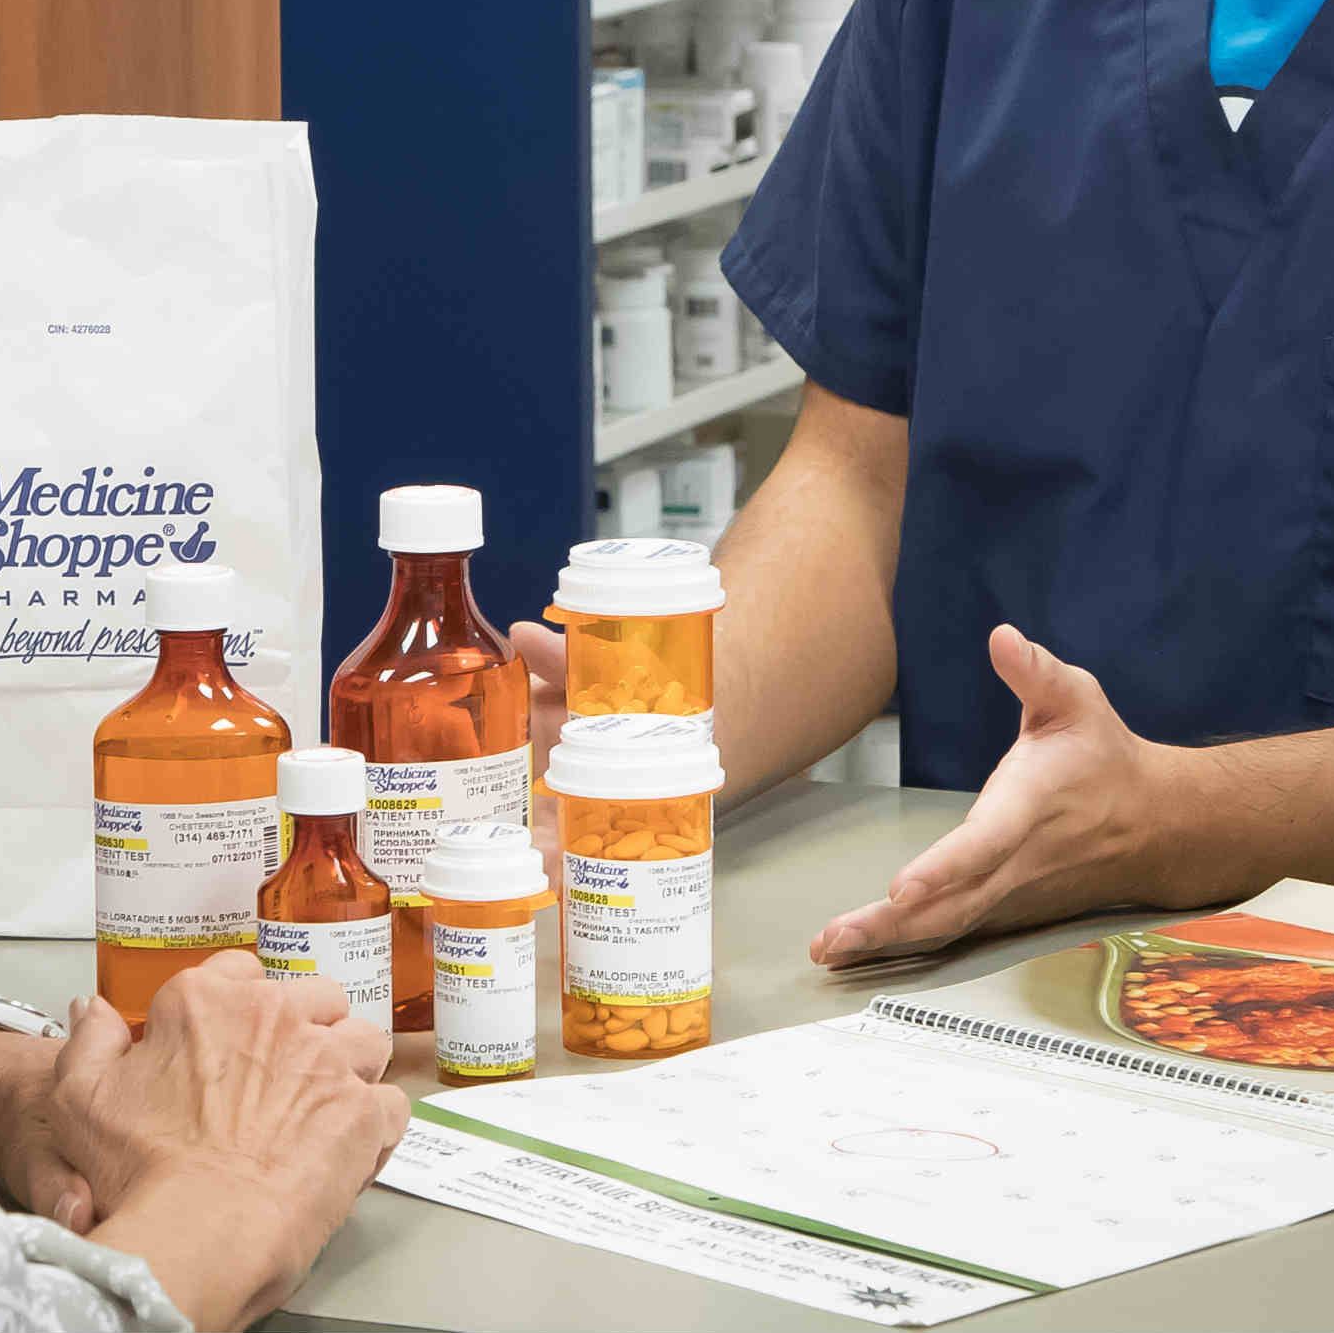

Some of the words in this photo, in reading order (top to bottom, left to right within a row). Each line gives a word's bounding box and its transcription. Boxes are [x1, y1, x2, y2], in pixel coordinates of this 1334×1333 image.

[47, 324, 70, 335] CIN:
[368, 767, 436, 782] Medicine
[374, 779, 425, 793] Shoppe
[368, 799, 418, 810] 1008629
[365, 810, 414, 822] PATIENT
[419, 810, 444, 819] TEST
[174, 832, 203, 844] (314)
[373, 839, 436, 847] ИСПОЛЬЗОВА
[124, 852, 152, 862] TEST
[211, 850, 263, 864] 07/12/2017
[570, 858, 629, 876] Medicine
[573, 873, 616, 889] Shoppe
[567, 900, 604, 916] PATIENT
[609, 908, 637, 918] TEST
[110, 912, 165, 924] LORATADINE
[202, 914, 216, 924] ML
[218, 911, 252, 922] SYRUP
[343, 949, 370, 963] (314)
[589, 970, 658, 982] AMLODIPINE
[663, 970, 685, 981] 5MG
[466, 978, 496, 989] TEST
[346, 983, 390, 1005] TIMES
[448, 1040, 520, 1054] CITALOPRAM
[504, 1155, 580, 1181] BETTER
[633, 1199, 711, 1224] BETTER
